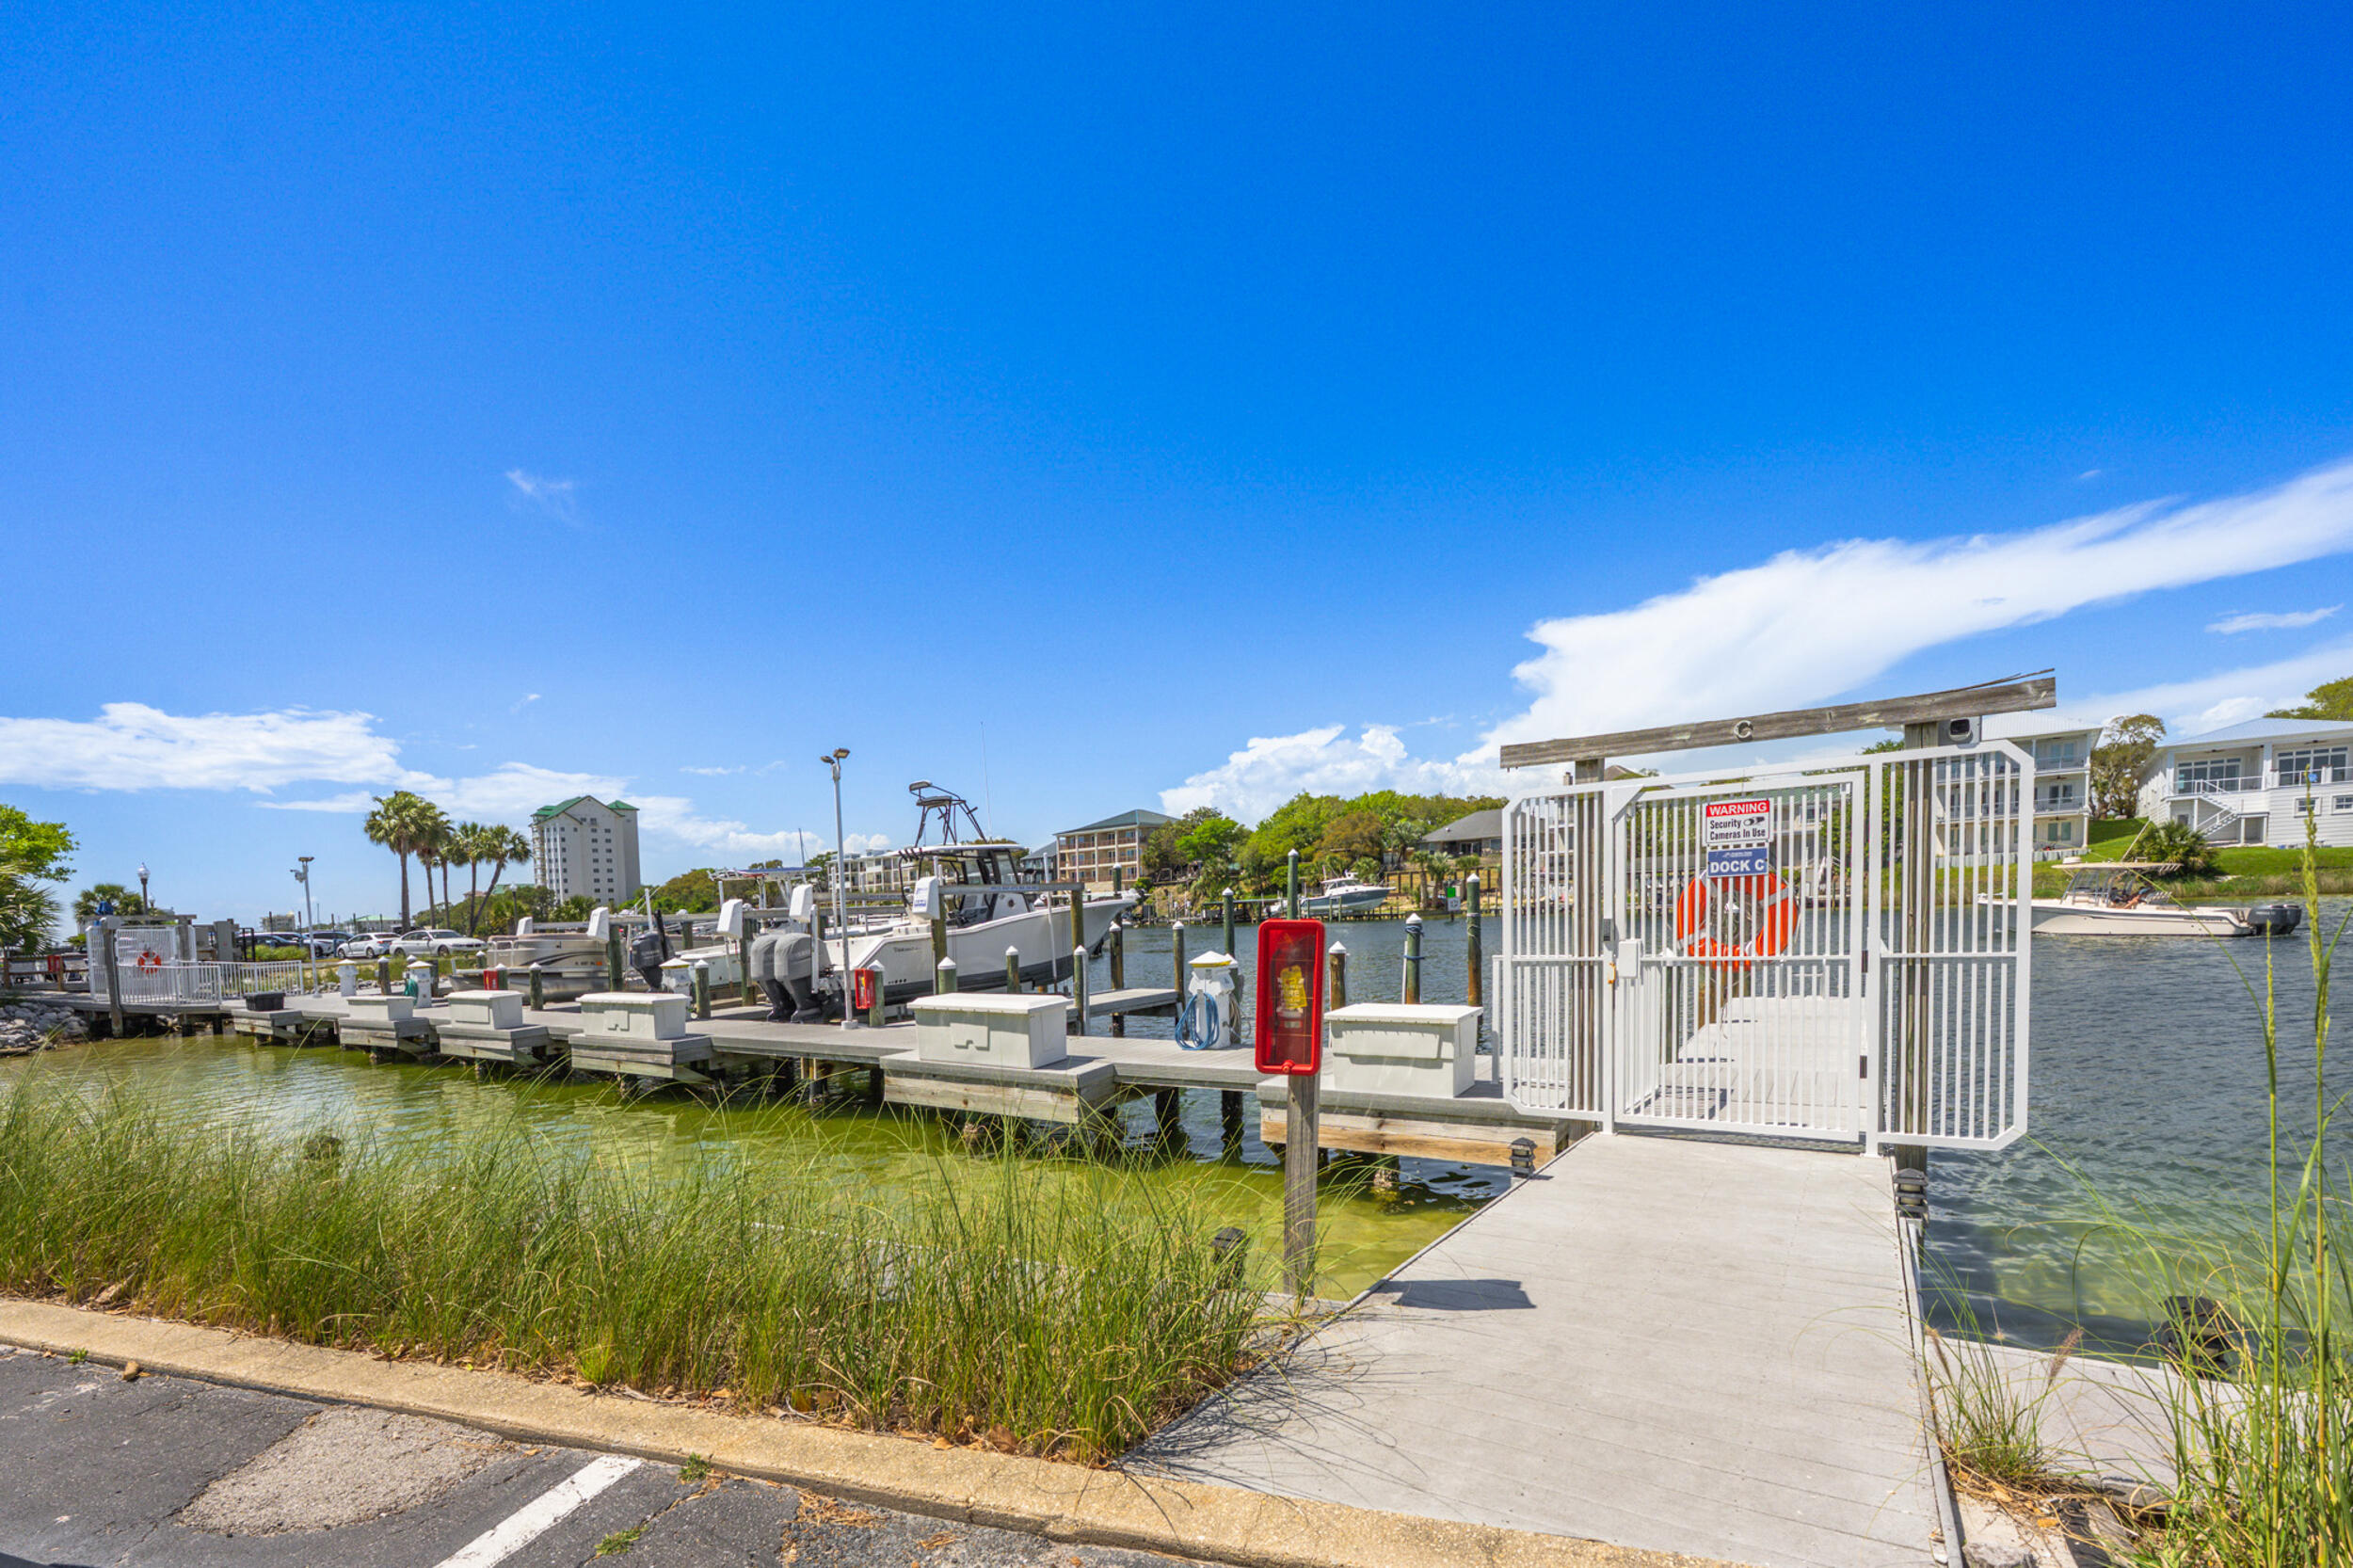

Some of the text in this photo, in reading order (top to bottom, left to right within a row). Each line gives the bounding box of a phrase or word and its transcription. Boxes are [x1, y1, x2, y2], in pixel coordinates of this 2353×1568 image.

[1734, 720, 1753, 739] C
[1709, 802, 1768, 816] WARNING
[1709, 819, 1741, 829] Security
[1709, 828, 1766, 840] Cameras In Use
[1710, 858, 1765, 873] DOCK C
